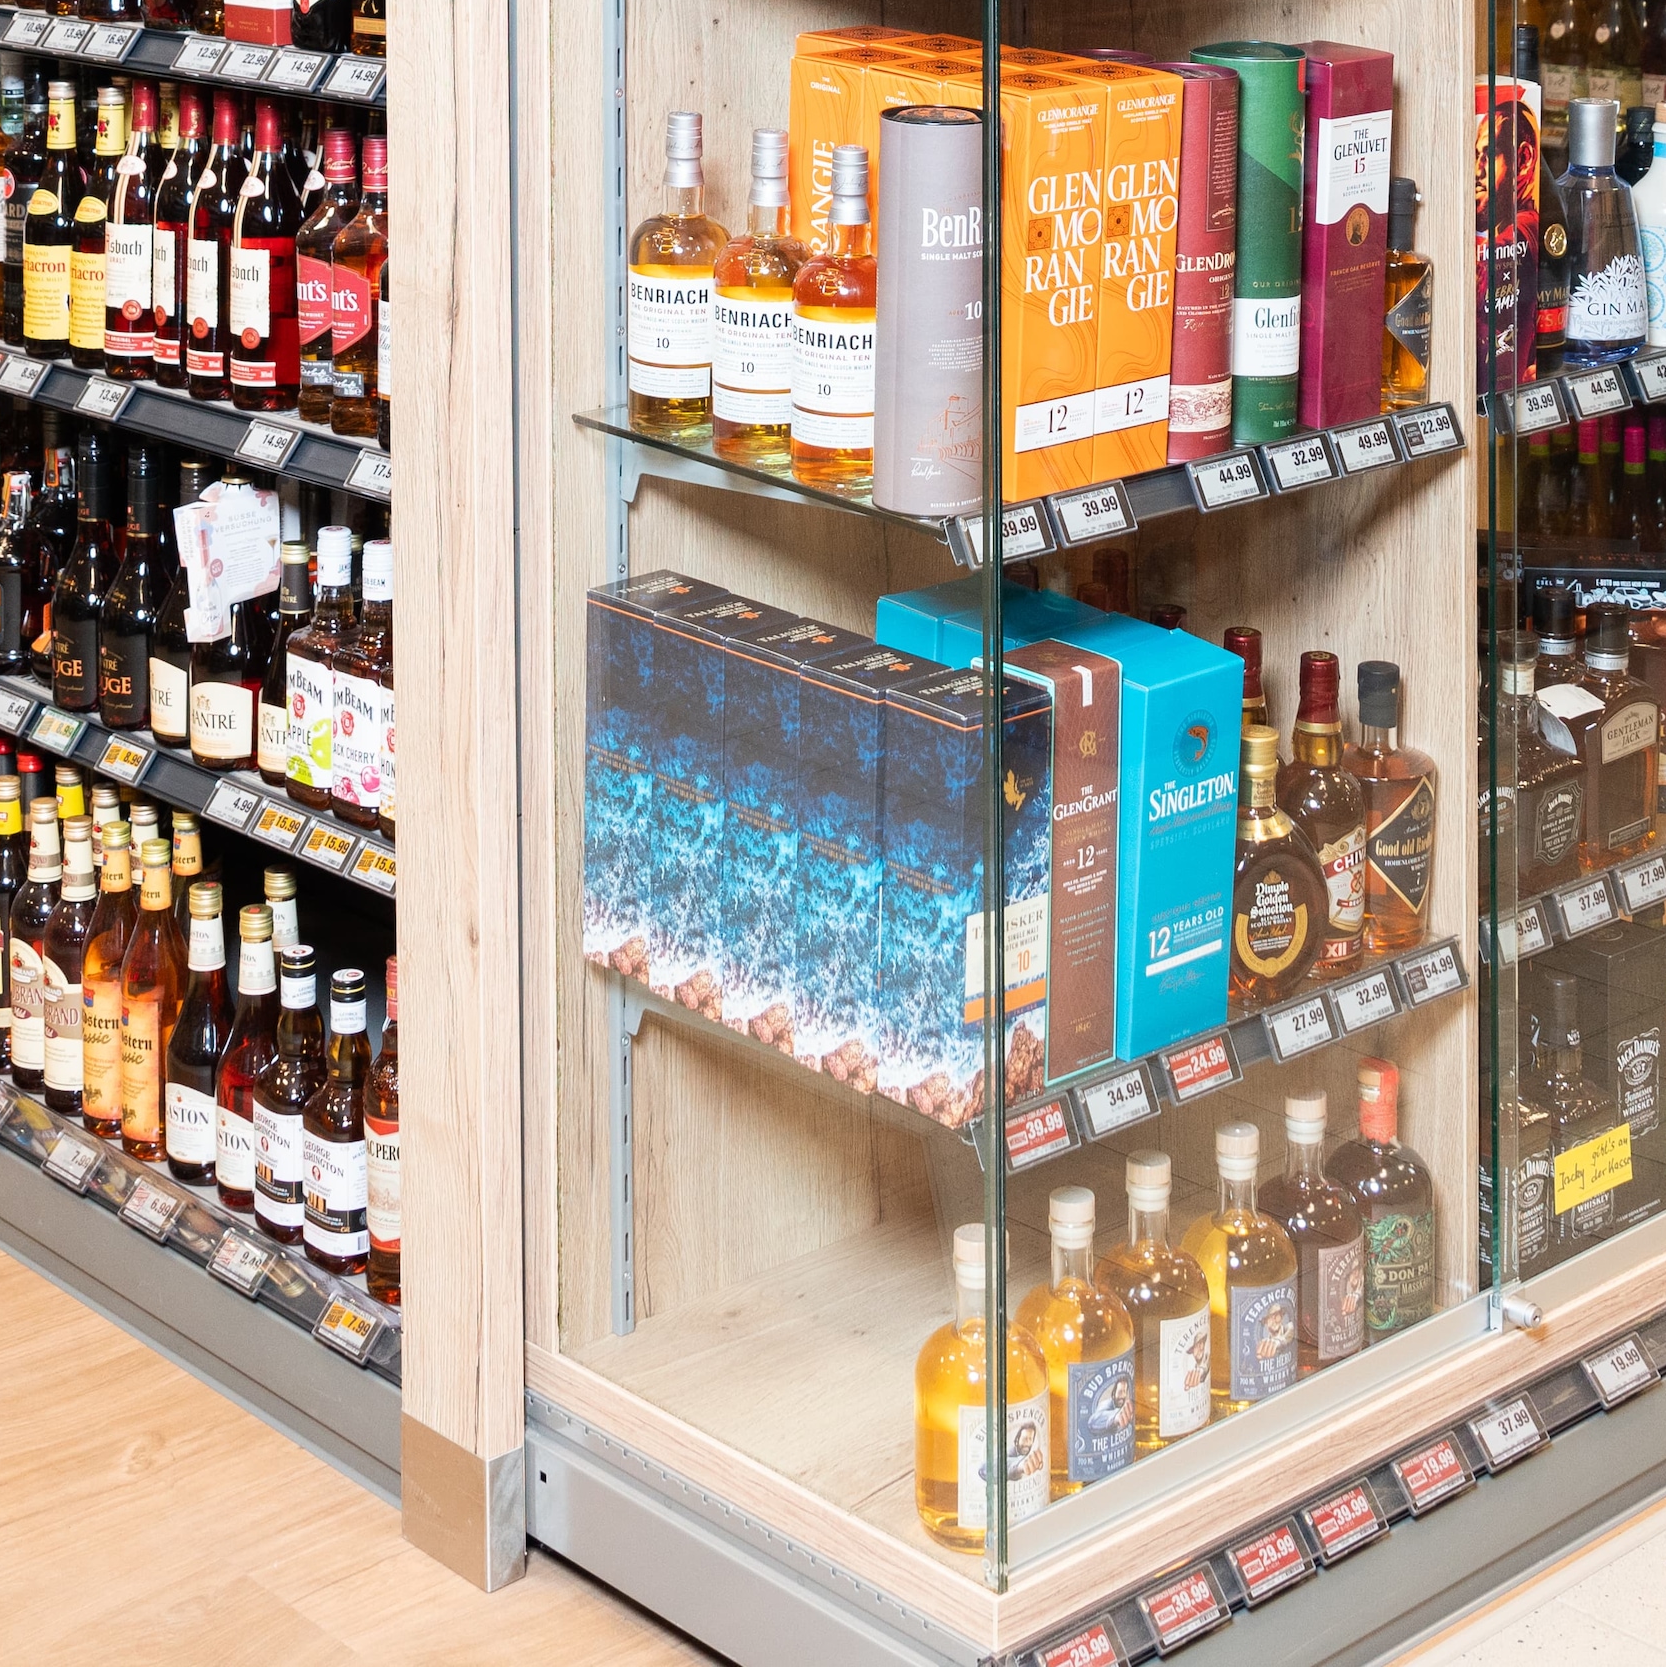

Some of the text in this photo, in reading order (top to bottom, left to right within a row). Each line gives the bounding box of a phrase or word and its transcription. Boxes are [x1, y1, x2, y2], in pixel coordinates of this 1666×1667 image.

[197, 47, 221, 58] 12.99
[242, 54, 268, 65] 22.99
[291, 60, 316, 73] 14.99
[351, 69, 376, 81] 14.99
[1117, 93, 1176, 112] GLENMORANGIE
[1038, 104, 1099, 123] GLENMORANGIE
[1354, 129, 1369, 139] THE
[1334, 137, 1387, 161] GLENLIVET
[1354, 158, 1365, 174] 15
[1107, 158, 1179, 202] GLEN
[1028, 168, 1102, 215] GLEN
[1132, 195, 1178, 236] MO
[1053, 208, 1103, 250] MO
[953, 252, 971, 260] MALT
[1103, 235, 1162, 279] RAN
[1024, 249, 1085, 294] RAN
[631, 282, 708, 304] BENRIACH
[1127, 271, 1170, 312] GIE
[643, 306, 685, 316] ORIGINAL
[965, 300, 982, 320] 10
[1048, 285, 1093, 327] GIE
[1588, 302, 1621, 315] GIN
[656, 338, 670, 350] 10
[793, 324, 872, 350] BENRIACH
[804, 350, 848, 361] ORIGINAL
[741, 362, 754, 374] 10
[99, 389, 121, 403] 13.99
[818, 384, 831, 396] 10
[1591, 378, 1617, 395] 44.95
[1124, 388, 1144, 416] 12
[1047, 405, 1067, 434] 12
[1420, 417, 1450, 434] 22.99
[1293, 447, 1325, 466] 32.99
[1219, 464, 1252, 483] 44.99
[1082, 496, 1118, 516] 39.99
[1607, 714, 1654, 741] GENTLEMAN
[1622, 730, 1641, 745] JACK
[347, 750, 374, 765] CHERRY
[1081, 785, 1093, 795] THE
[1164, 781, 1175, 791] THE
[233, 798, 253, 813] 4.99
[1149, 772, 1234, 822] SINGLETON
[276, 815, 300, 834] 15.99
[324, 837, 349, 854] 15.99
[1375, 839, 1414, 857] Good old
[1077, 844, 1095, 870] 12
[1578, 891, 1606, 909] 37.99
[1149, 906, 1224, 958] 12 YEARS OLD
[1326, 942, 1347, 957] XII
[1017, 950, 1029, 972] 10
[1423, 956, 1454, 980] 54.99
[1356, 983, 1387, 1006] 32.99
[1292, 1008, 1325, 1031] 27.99
[1191, 1046, 1225, 1074] 24.99
[1107, 1079, 1143, 1106] 34.99
[1026, 1113, 1063, 1141] 39.99
[150, 1196, 170, 1217] 6.99
[1389, 1268, 1413, 1283] DON
[1245, 1286, 1284, 1324] TERENCE
[1083, 1374, 1104, 1399] BUD
[1092, 1439, 1109, 1452] THE
[1422, 1448, 1456, 1476] 19.99
